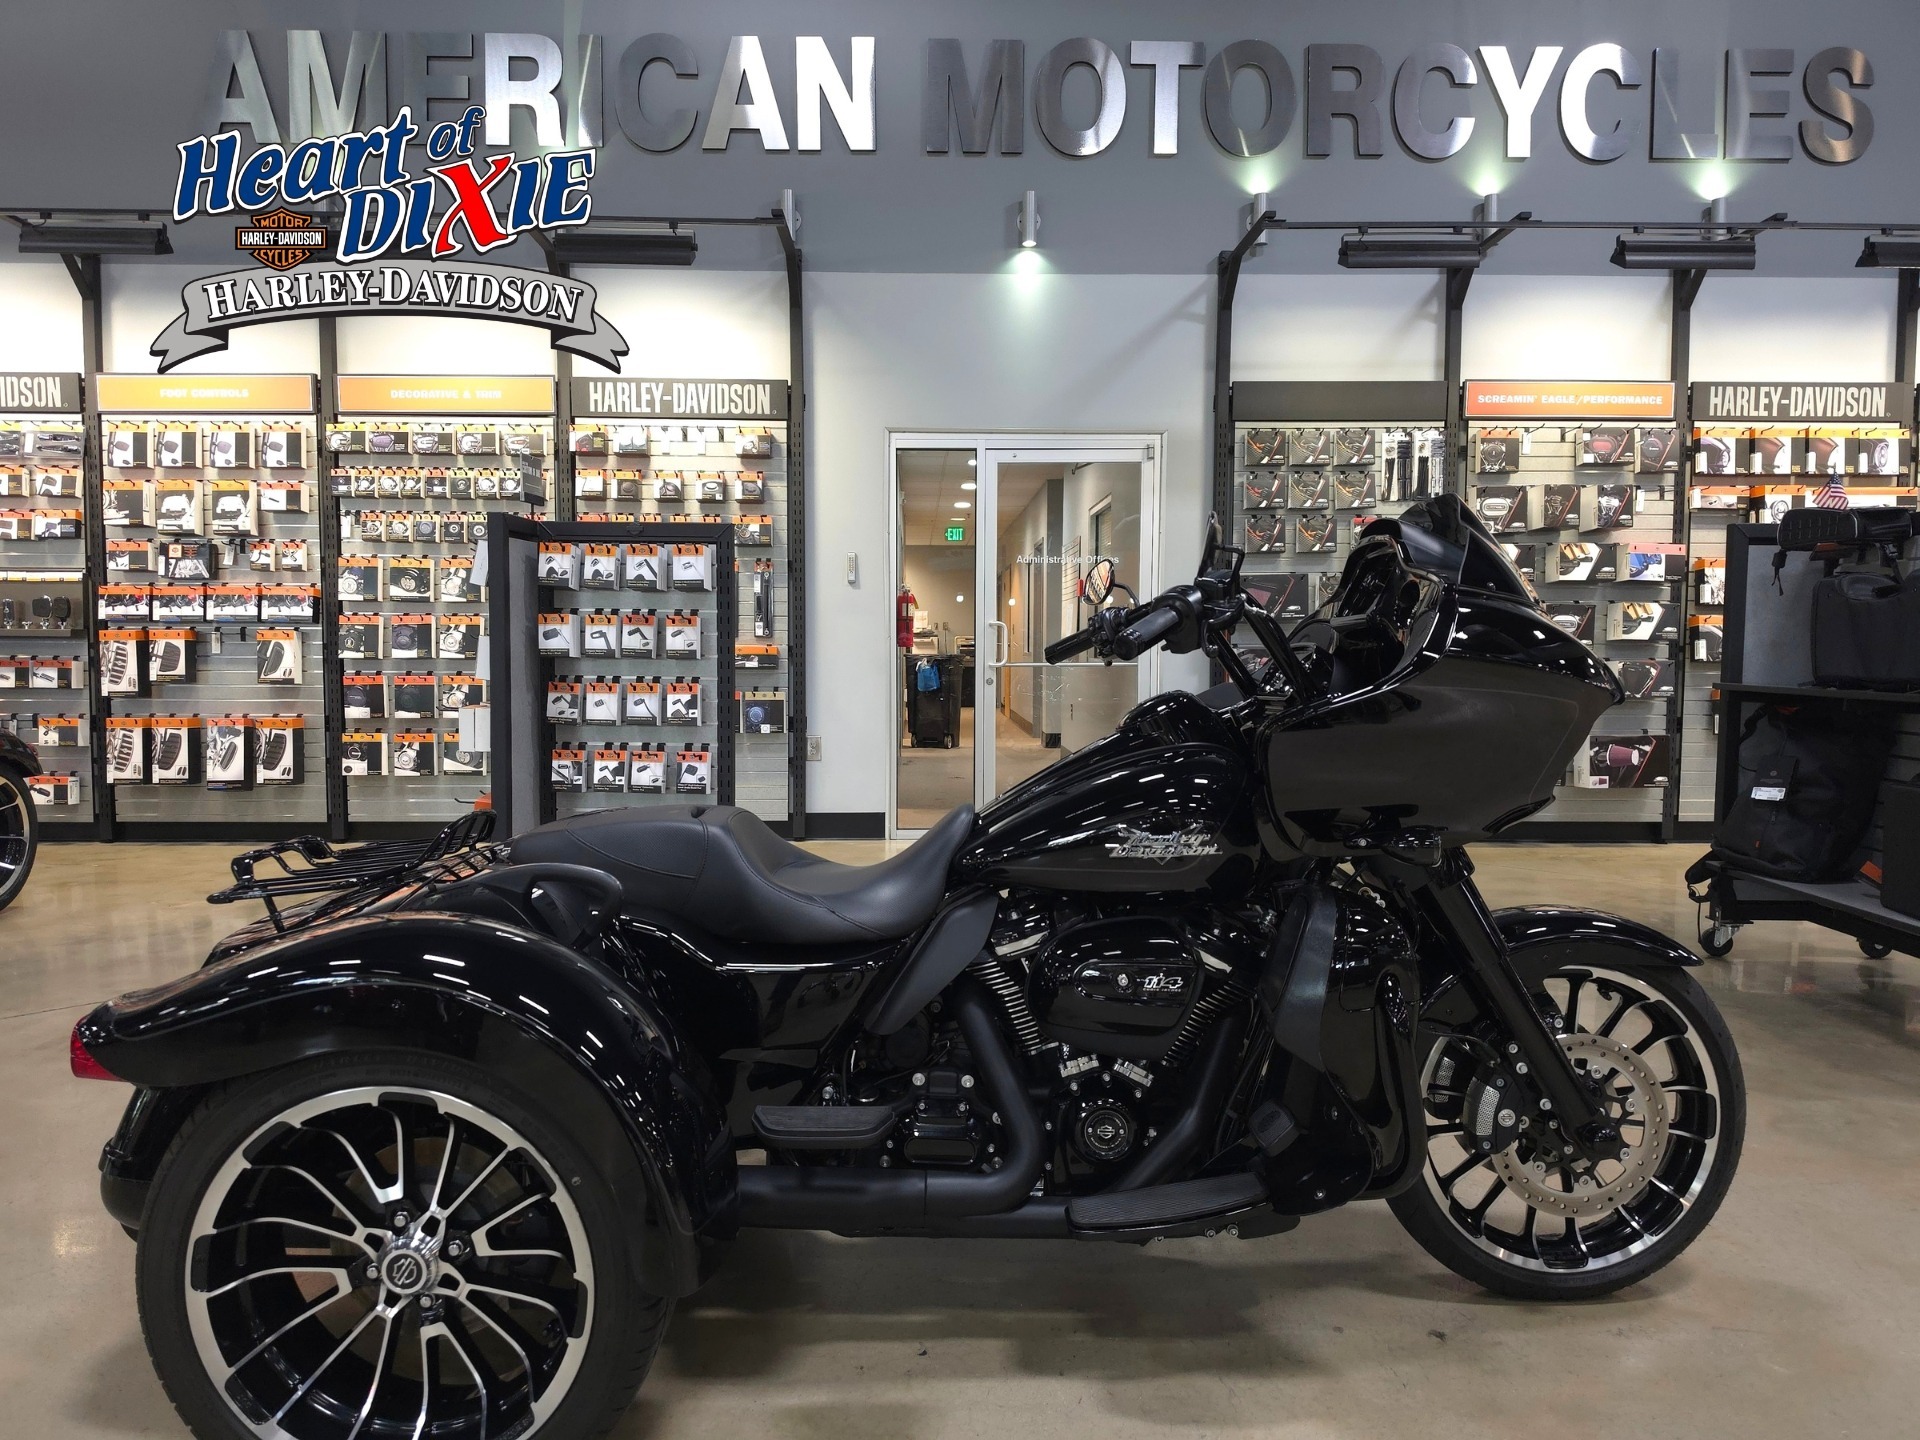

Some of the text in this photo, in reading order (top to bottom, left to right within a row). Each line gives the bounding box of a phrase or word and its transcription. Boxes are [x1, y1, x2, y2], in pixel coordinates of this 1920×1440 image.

[203, 29, 1876, 163] AMERICAN MOTORCYCLES
[160, 389, 249, 398] FOOT CONTROLS
[390, 389, 459, 399] DECORATIVE
[475, 389, 502, 399] TRIM
[589, 381, 771, 415] HARLEY-DAVIDSON
[1477, 394, 1663, 405] SCREAMIN' EAGLE/PERFORMANCE
[1709, 385, 1887, 418] HARLEY-DAVIDSON
[947, 528, 964, 541] EXIT
[1016, 555, 1083, 564] Administrative
[1144, 976, 1183, 988] 114
